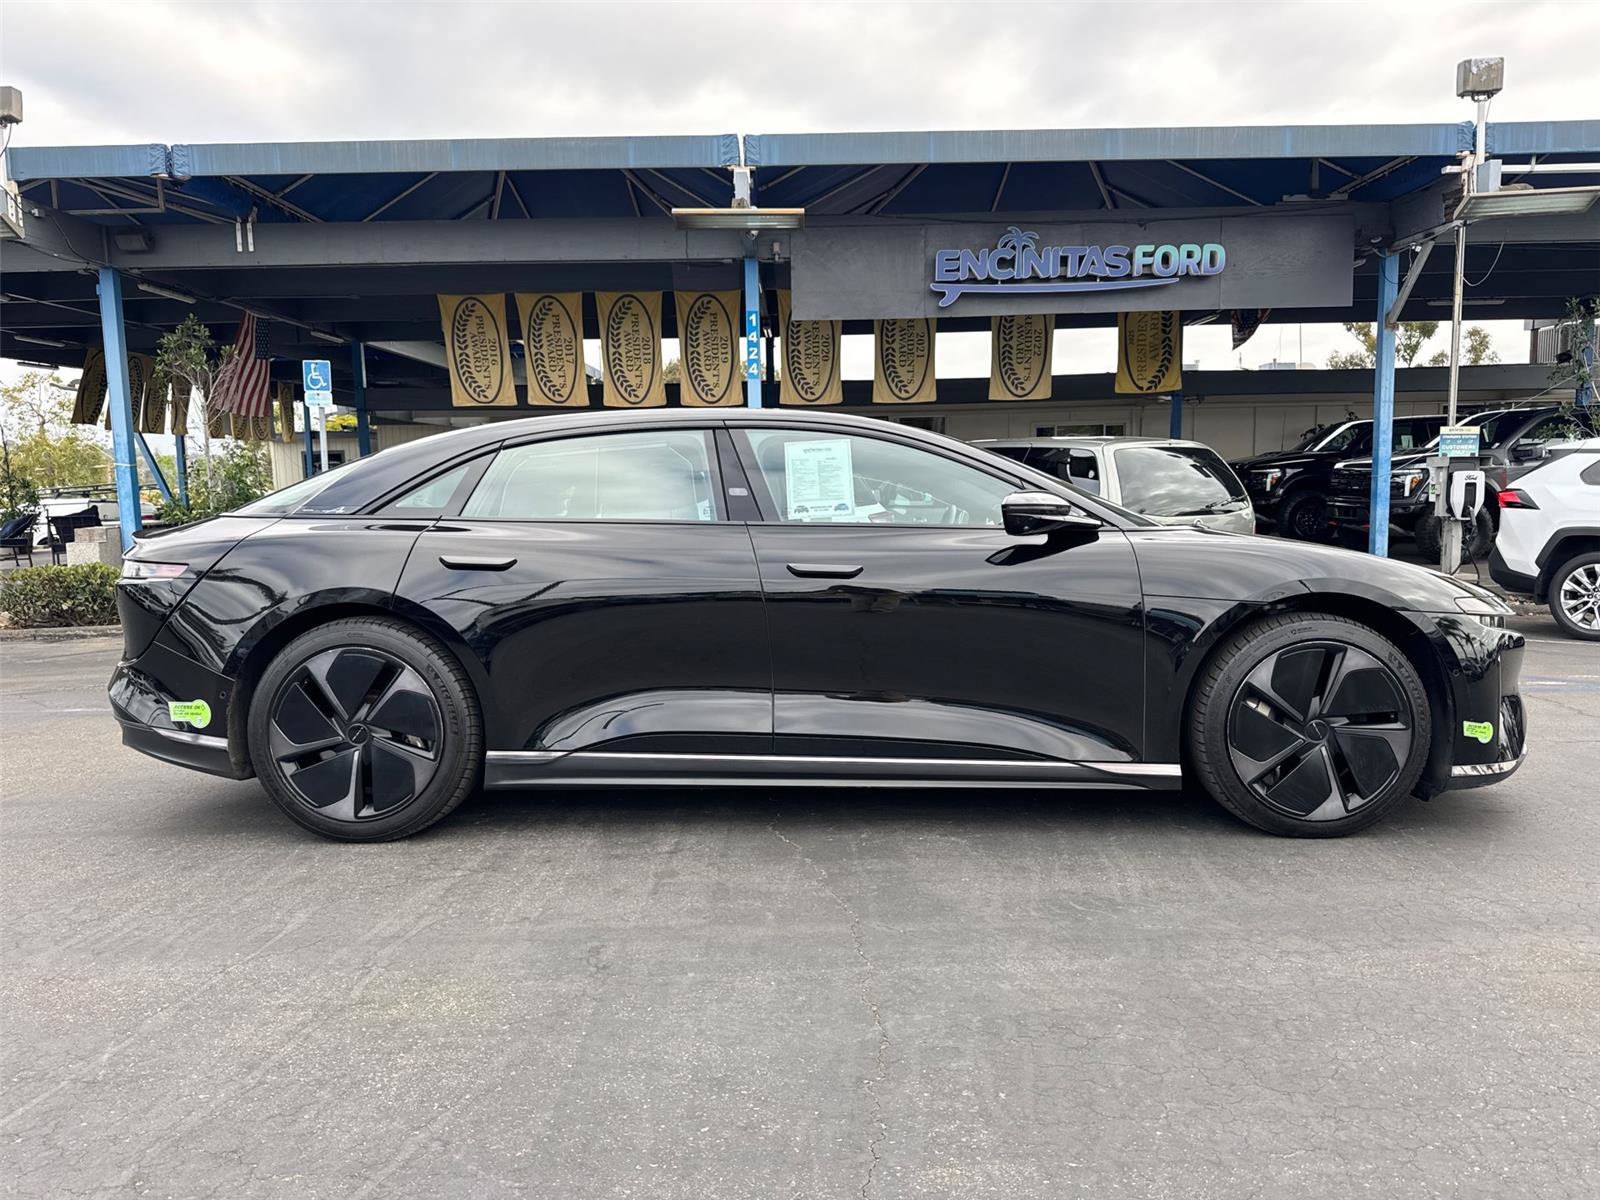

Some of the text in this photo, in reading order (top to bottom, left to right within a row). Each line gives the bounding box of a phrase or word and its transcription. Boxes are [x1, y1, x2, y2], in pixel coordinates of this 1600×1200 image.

[935, 243, 1226, 282] ENCINITAS FORD
[469, 331, 483, 373] AWARD
[475, 315, 492, 390] PRESIDENT'S
[488, 338, 499, 366] 2016
[545, 331, 557, 372] AWARD
[551, 314, 567, 390] PRESIDENT'S
[564, 337, 575, 364] 2017
[624, 331, 634, 372] AWARD
[631, 313, 643, 390] PRESIDENT'S
[641, 336, 652, 365] 2018
[702, 330, 711, 372] AWARD
[709, 312, 720, 389] PRESIDENT'S
[719, 336, 729, 364] 2019
[748, 313, 759, 376] 1424
[804, 329, 813, 370] AWARD
[811, 320, 820, 387] RESIDENT'S
[821, 334, 831, 362] 2020
[898, 326, 907, 368] AWARD
[907, 319, 915, 385] RESIDENT'S
[916, 331, 926, 359] 2021
[1015, 324, 1024, 365] AWARD
[1024, 315, 1033, 382] RESIDENT'S
[1034, 328, 1043, 357] 2022
[1136, 312, 1149, 381] PRESIDEN
